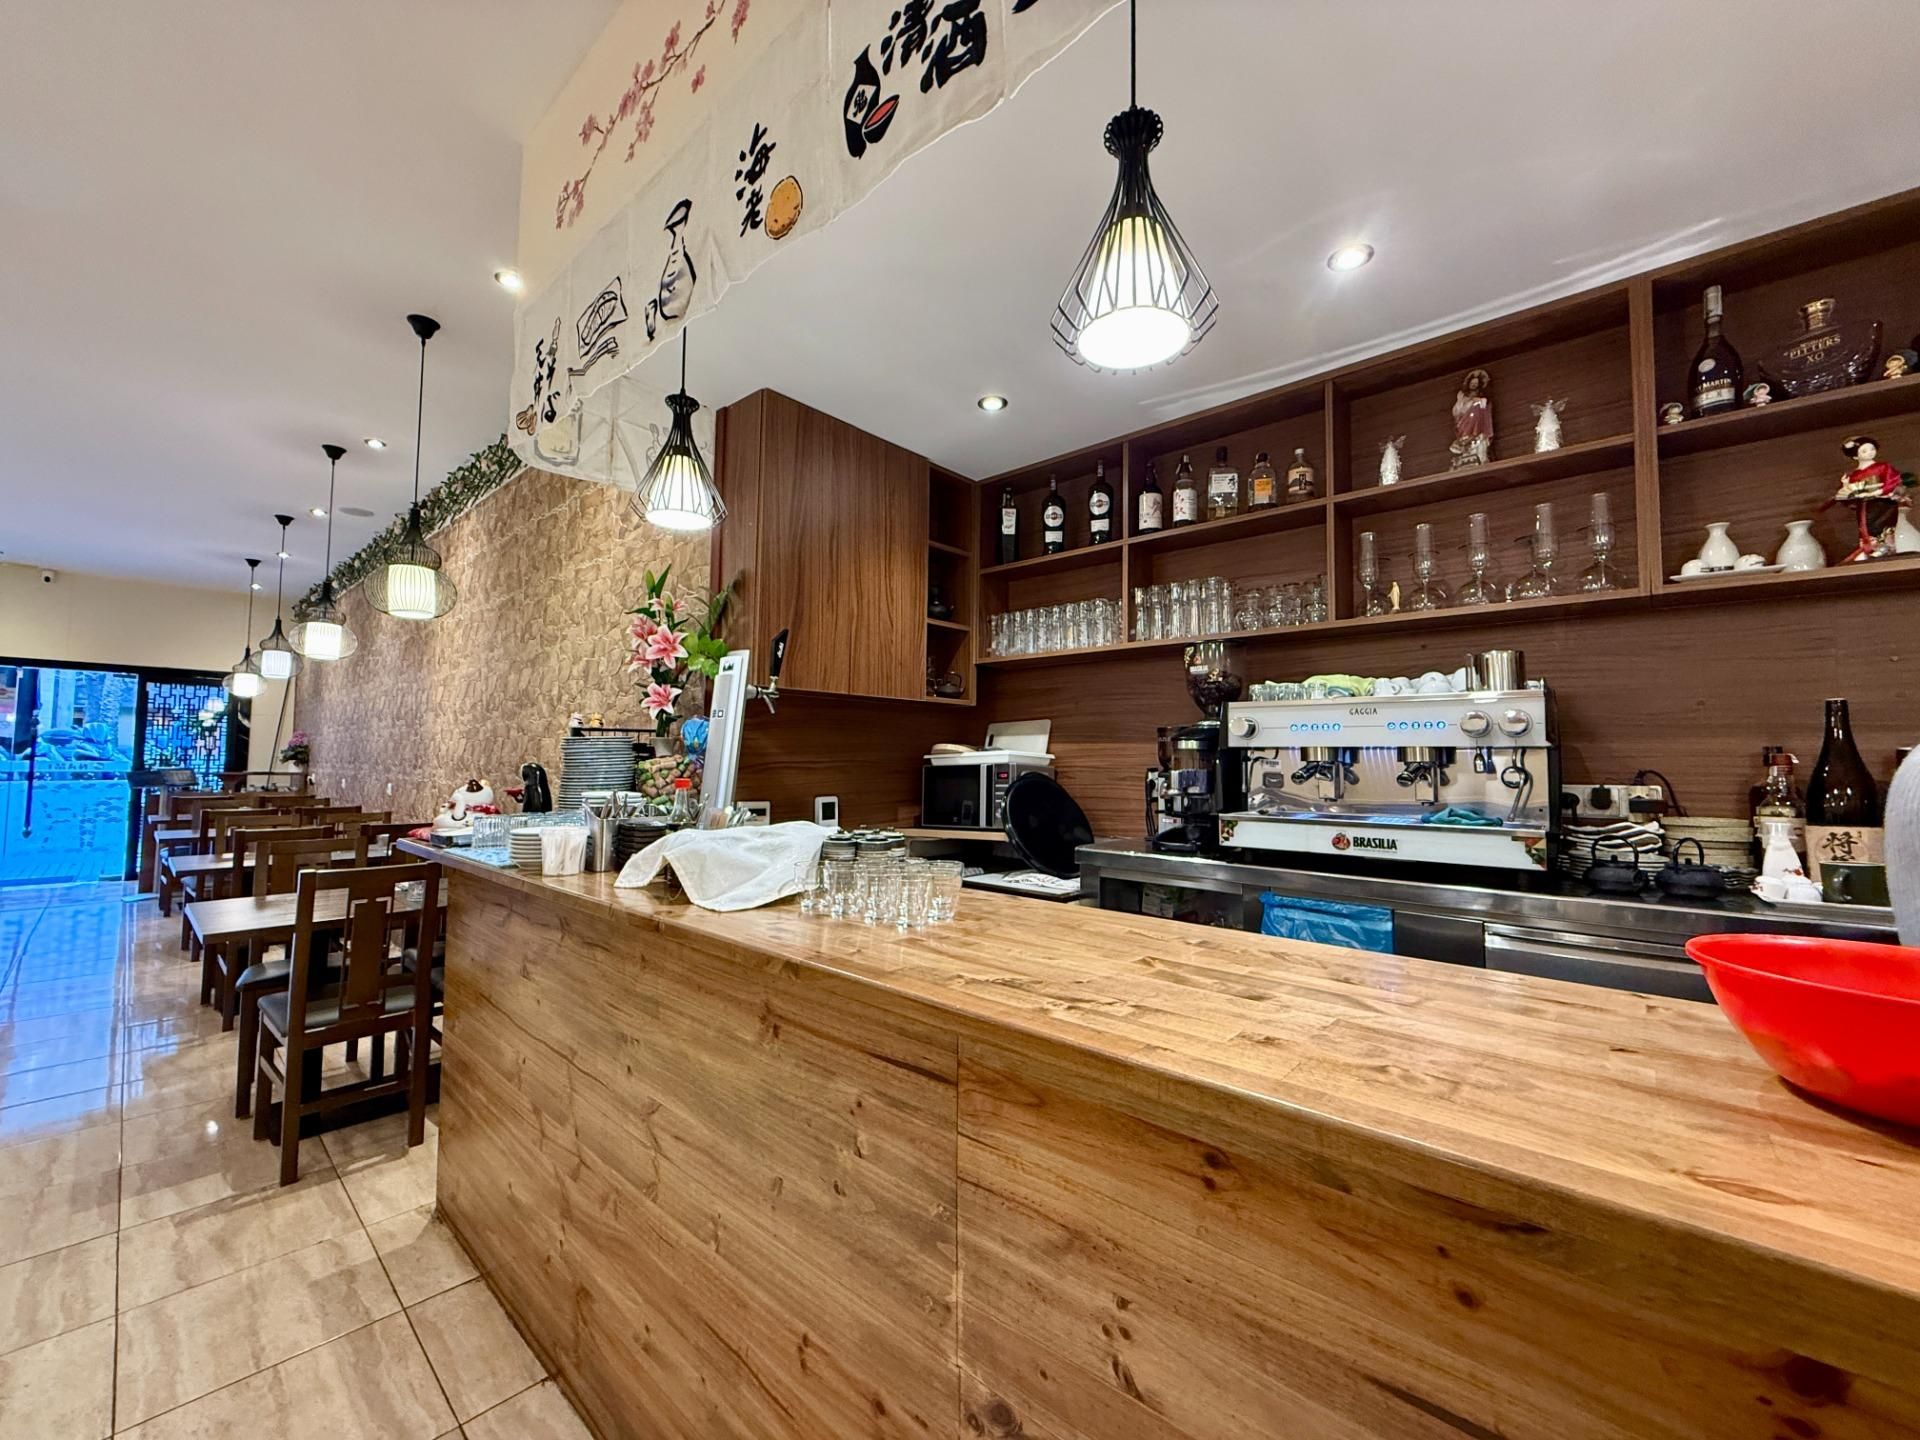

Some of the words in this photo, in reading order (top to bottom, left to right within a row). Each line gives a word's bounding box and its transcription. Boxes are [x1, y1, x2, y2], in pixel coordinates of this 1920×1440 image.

[735, 123, 776, 237] 海老
[1349, 707, 1378, 716] GAGGIA
[1353, 836, 1398, 851] BRASILIA
